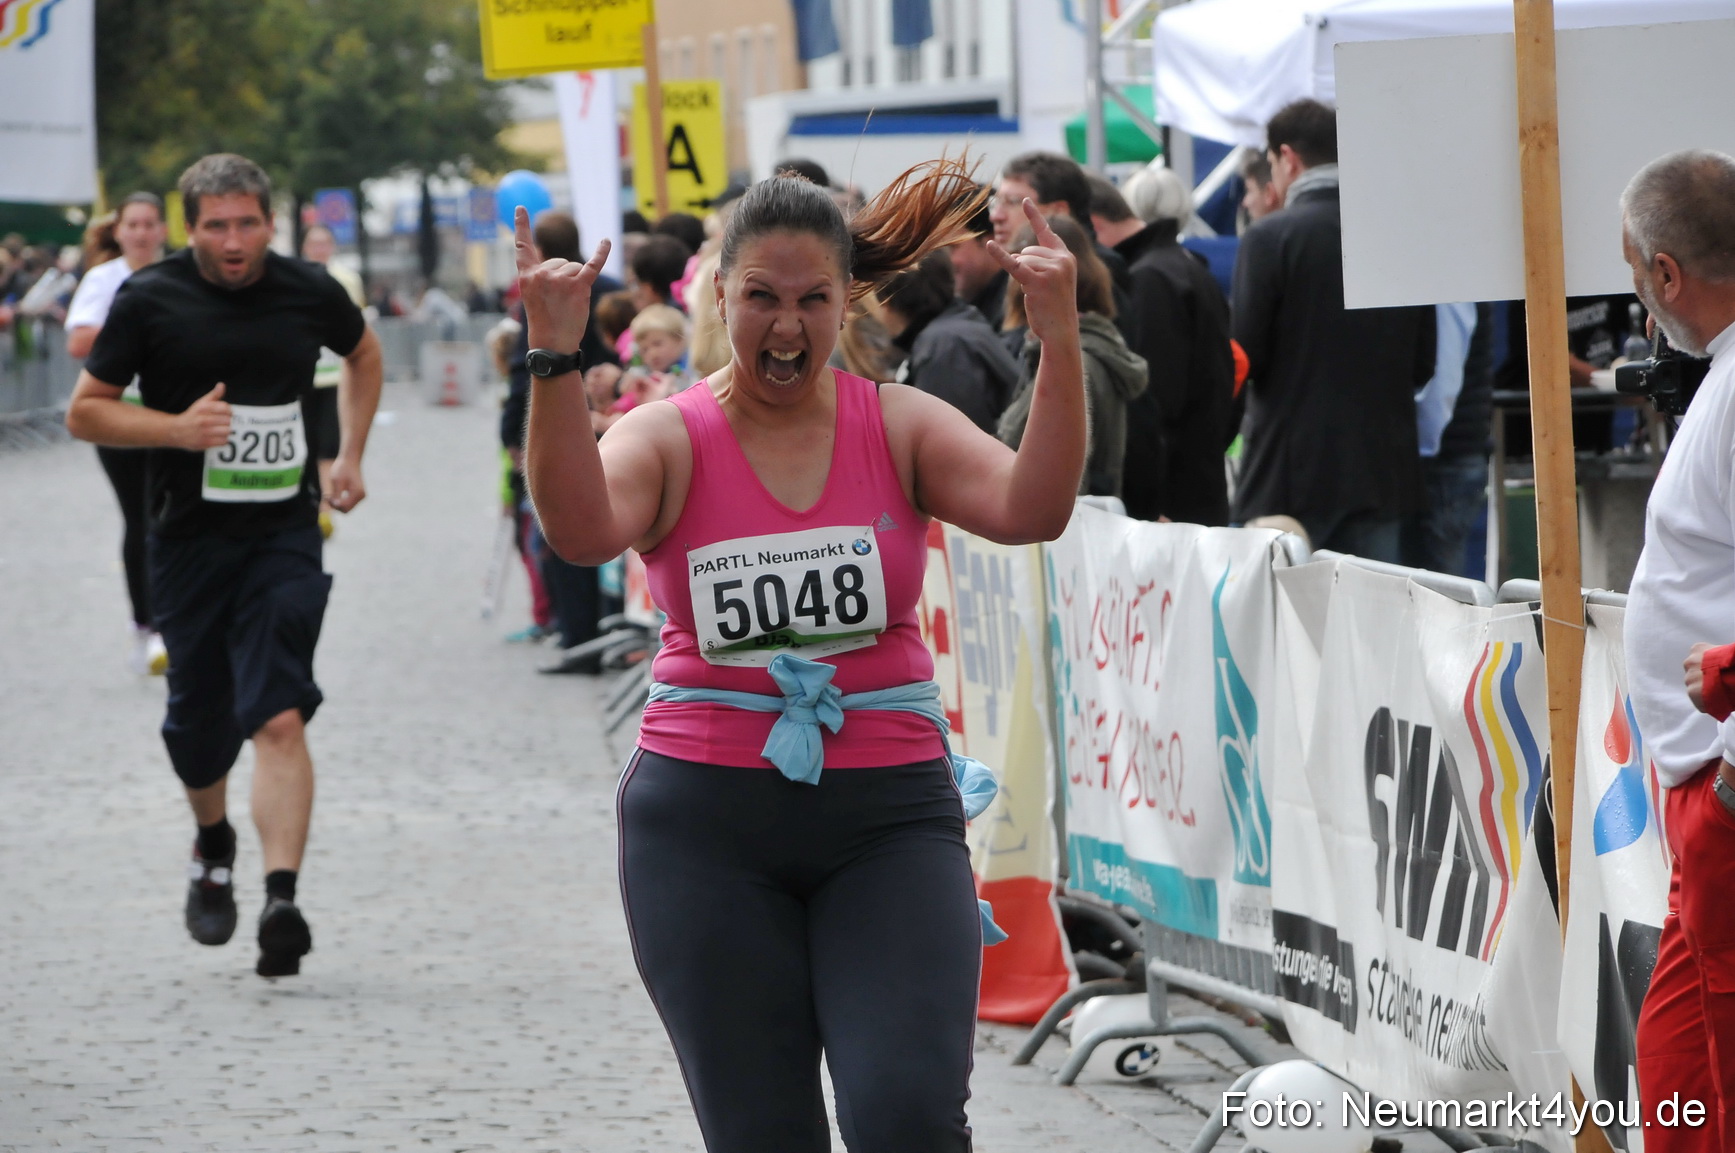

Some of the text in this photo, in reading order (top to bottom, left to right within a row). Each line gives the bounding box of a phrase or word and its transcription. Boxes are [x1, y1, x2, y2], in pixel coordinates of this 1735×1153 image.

[545, 21, 592, 42] lauf
[663, 84, 710, 110] lock
[668, 123, 704, 185] A
[217, 427, 295, 464] 5203
[693, 554, 754, 577] PARTL
[758, 542, 846, 565] Neumarkt
[713, 563, 869, 641] 5048
